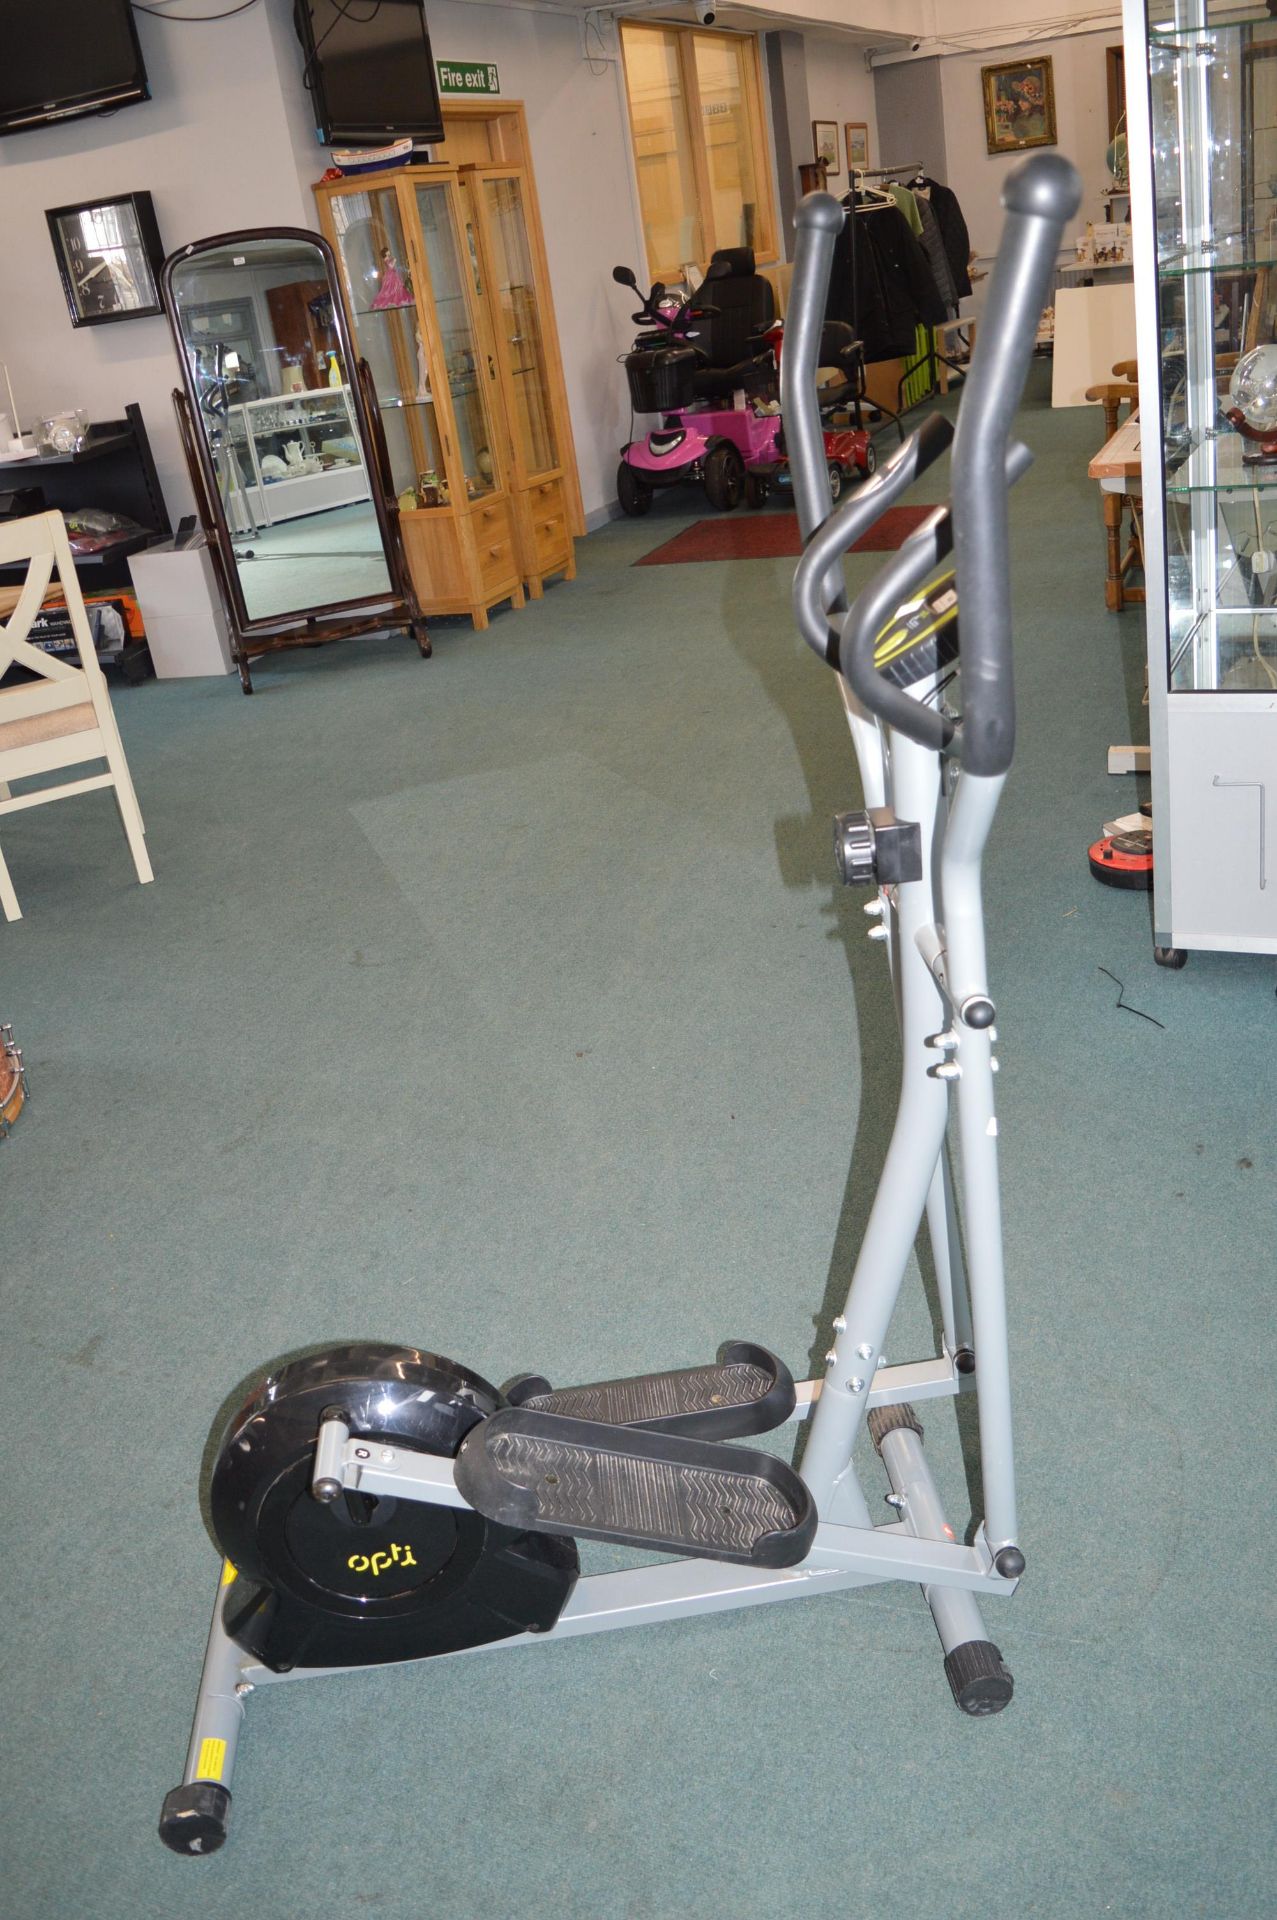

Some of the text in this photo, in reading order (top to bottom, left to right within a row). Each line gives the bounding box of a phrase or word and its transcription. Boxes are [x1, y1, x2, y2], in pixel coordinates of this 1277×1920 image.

[440, 67, 486, 88] Fire exit
[348, 1543, 417, 1576] opti
